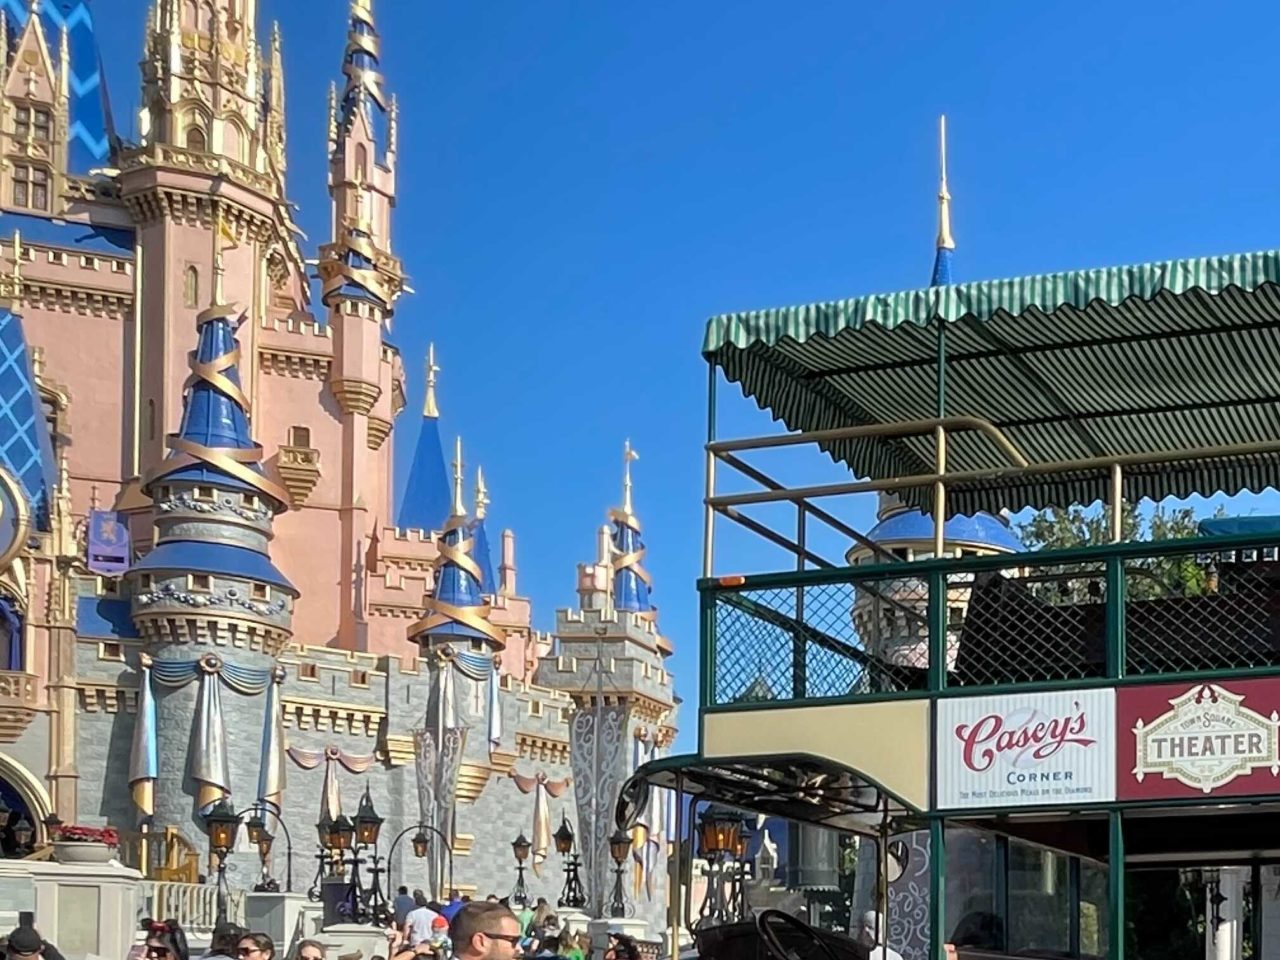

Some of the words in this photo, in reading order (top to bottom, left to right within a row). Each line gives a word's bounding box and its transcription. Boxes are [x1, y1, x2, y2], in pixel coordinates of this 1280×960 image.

[1180, 716, 1201, 730] TOWN
[1202, 711, 1236, 728] SQUARE
[955, 701, 1097, 772] Casey's
[1151, 732, 1262, 759] THEATER
